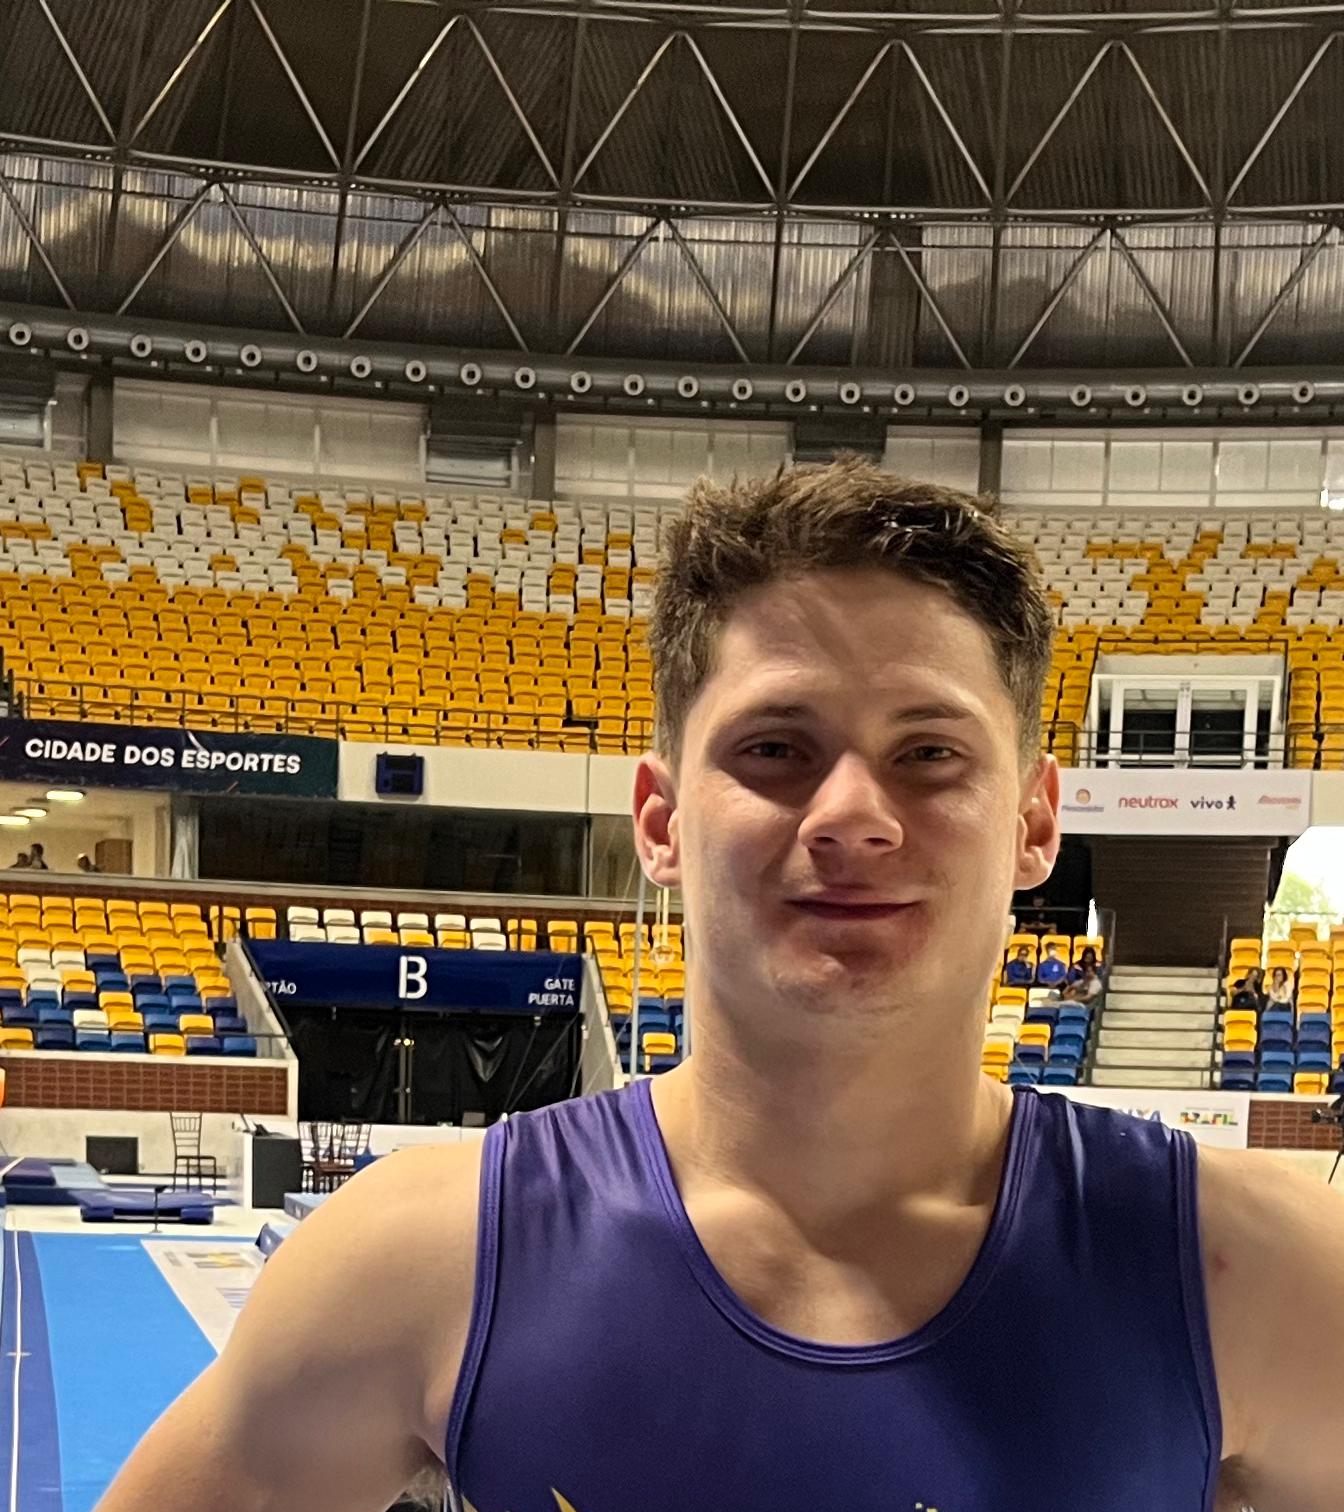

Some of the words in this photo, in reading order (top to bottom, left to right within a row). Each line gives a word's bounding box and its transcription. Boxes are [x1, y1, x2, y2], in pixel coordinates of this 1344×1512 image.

[25, 738, 116, 762] CIDADE
[123, 745, 174, 767] DOS
[181, 748, 301, 774] ESPORTES
[1118, 795, 1179, 809] neutrox
[1190, 796, 1223, 810] vivo
[398, 955, 429, 999] B
[544, 978, 575, 991] GATE
[528, 992, 575, 1005] PUERTA
